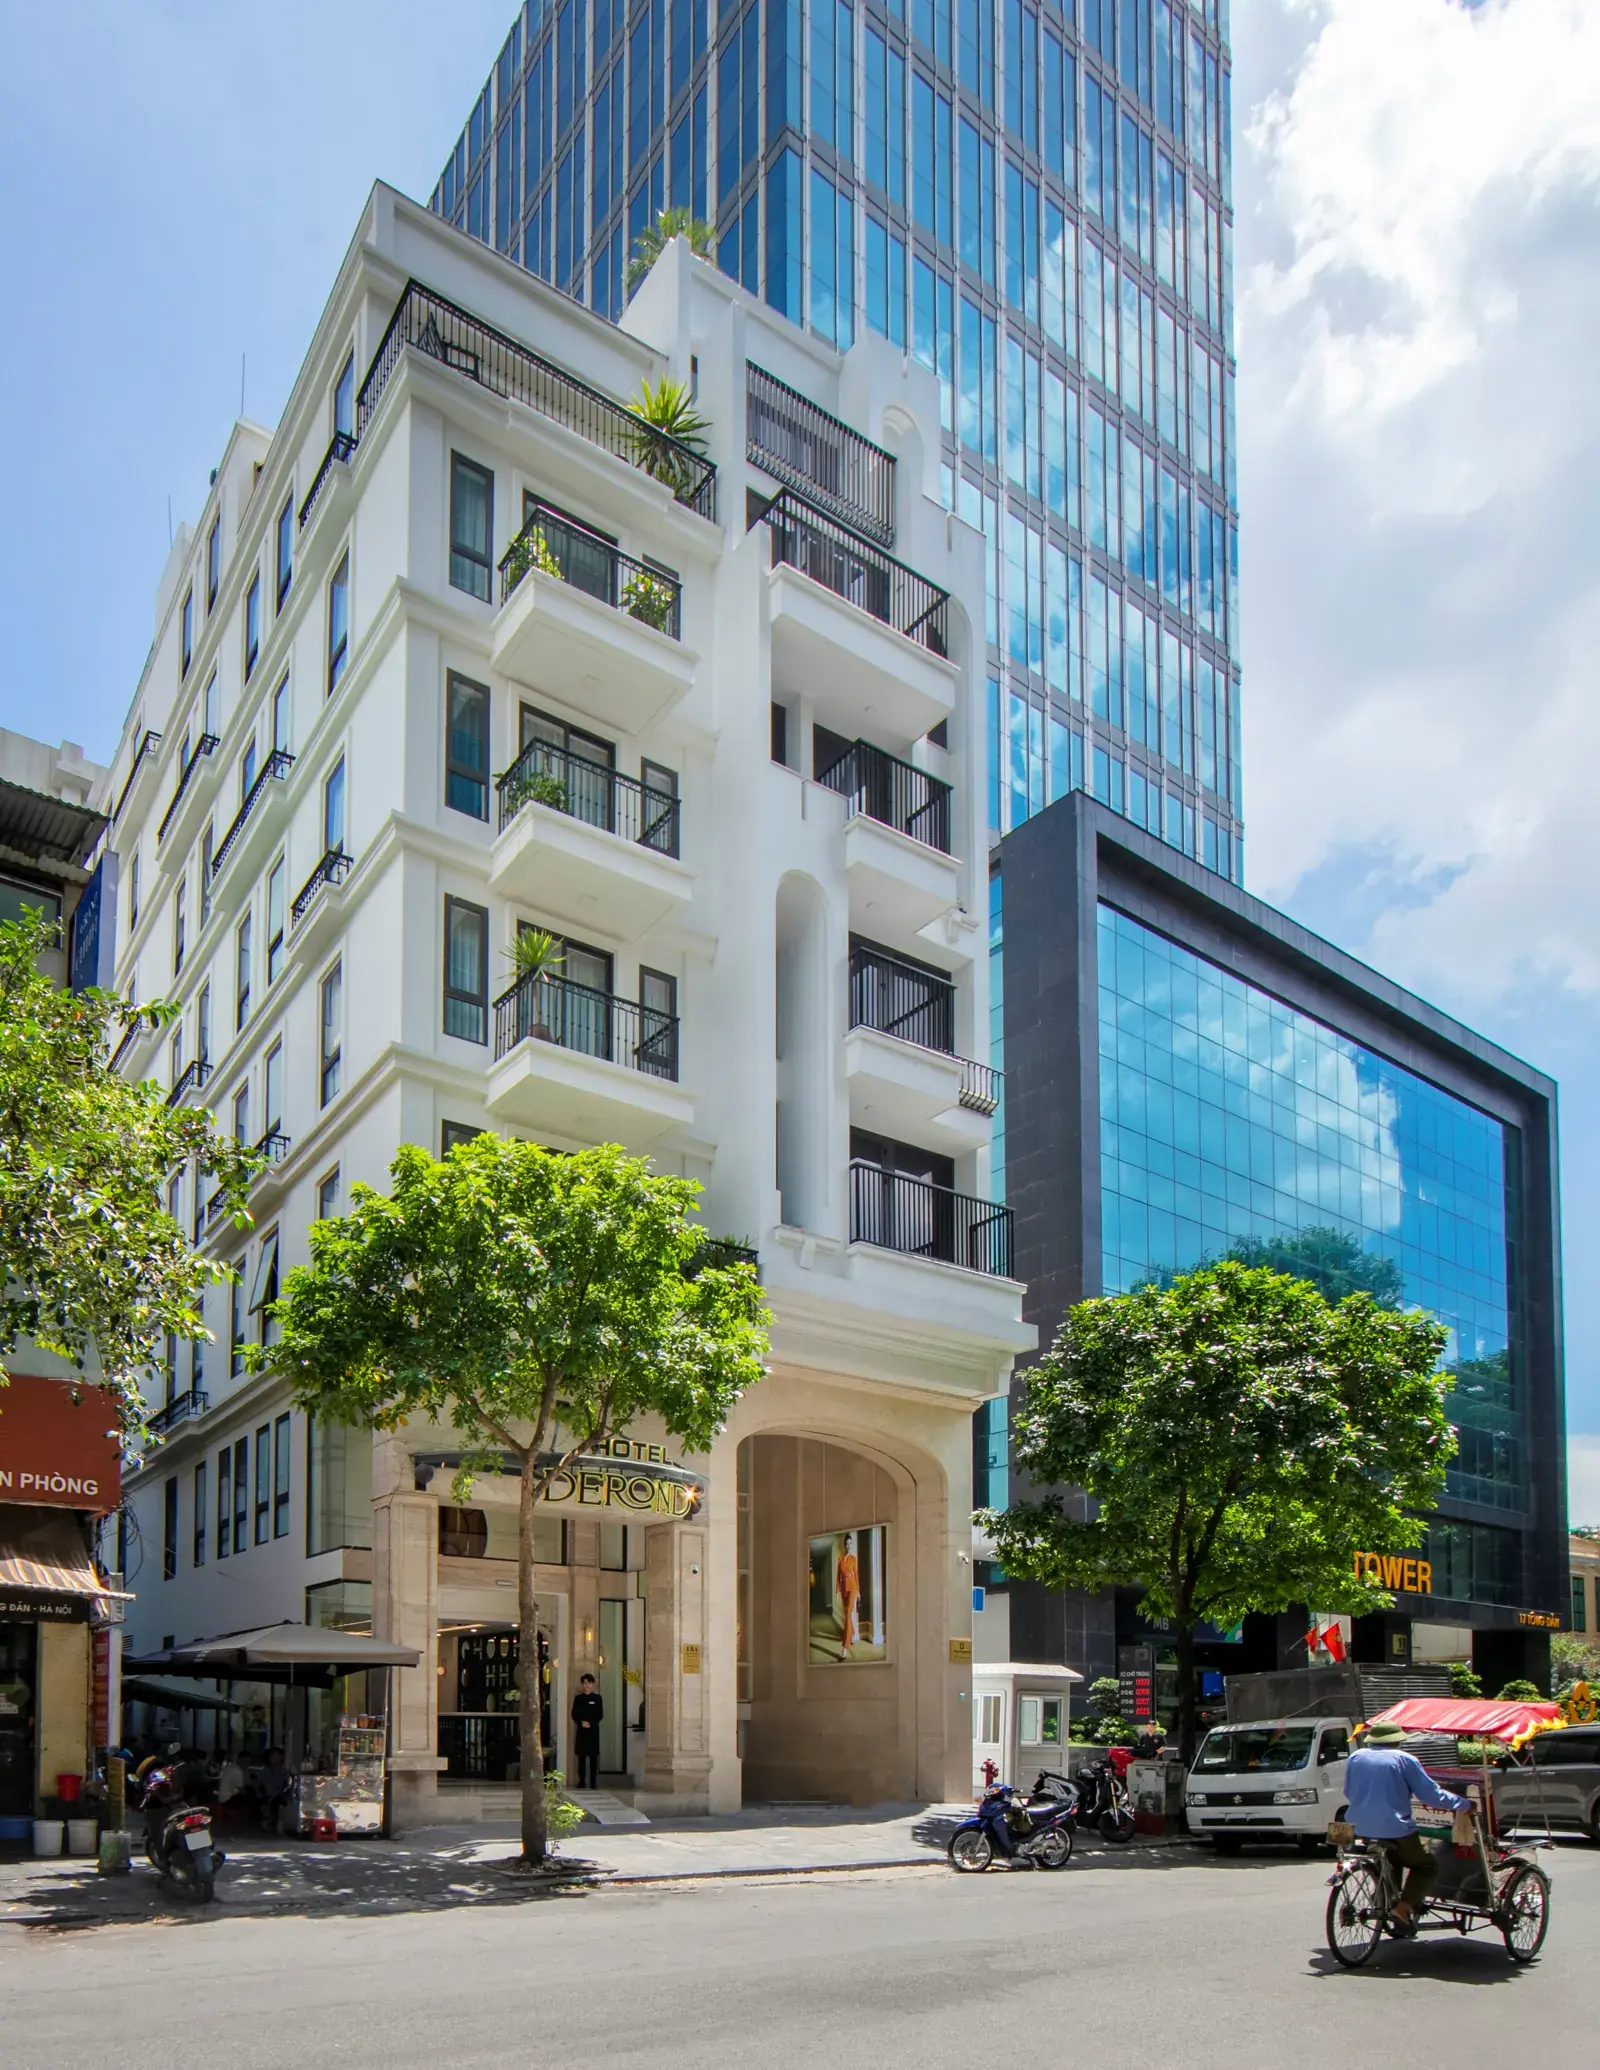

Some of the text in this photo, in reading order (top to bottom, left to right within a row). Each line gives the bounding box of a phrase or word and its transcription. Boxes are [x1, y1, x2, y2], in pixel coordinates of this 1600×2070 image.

[592, 1438, 673, 1466] HOTEL
[20, 1472, 98, 1495] PHÒNG
[1353, 1550, 1432, 1594] TOWER
